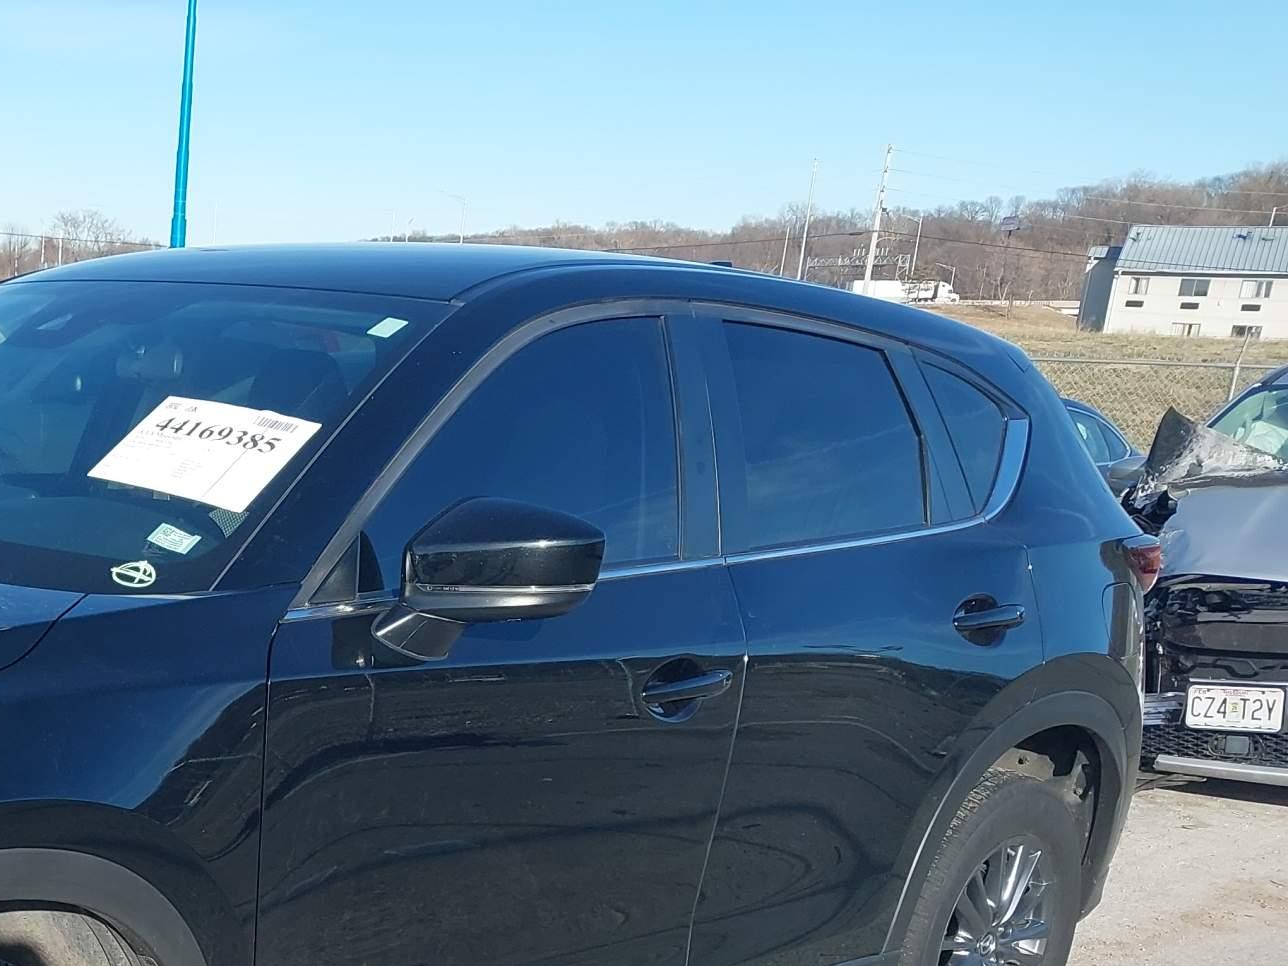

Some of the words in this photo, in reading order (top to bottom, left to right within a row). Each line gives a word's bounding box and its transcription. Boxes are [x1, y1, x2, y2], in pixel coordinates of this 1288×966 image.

[156, 417, 282, 453] 44169385
[1191, 696, 1228, 719] CZ4
[1240, 698, 1277, 721] T2Y
